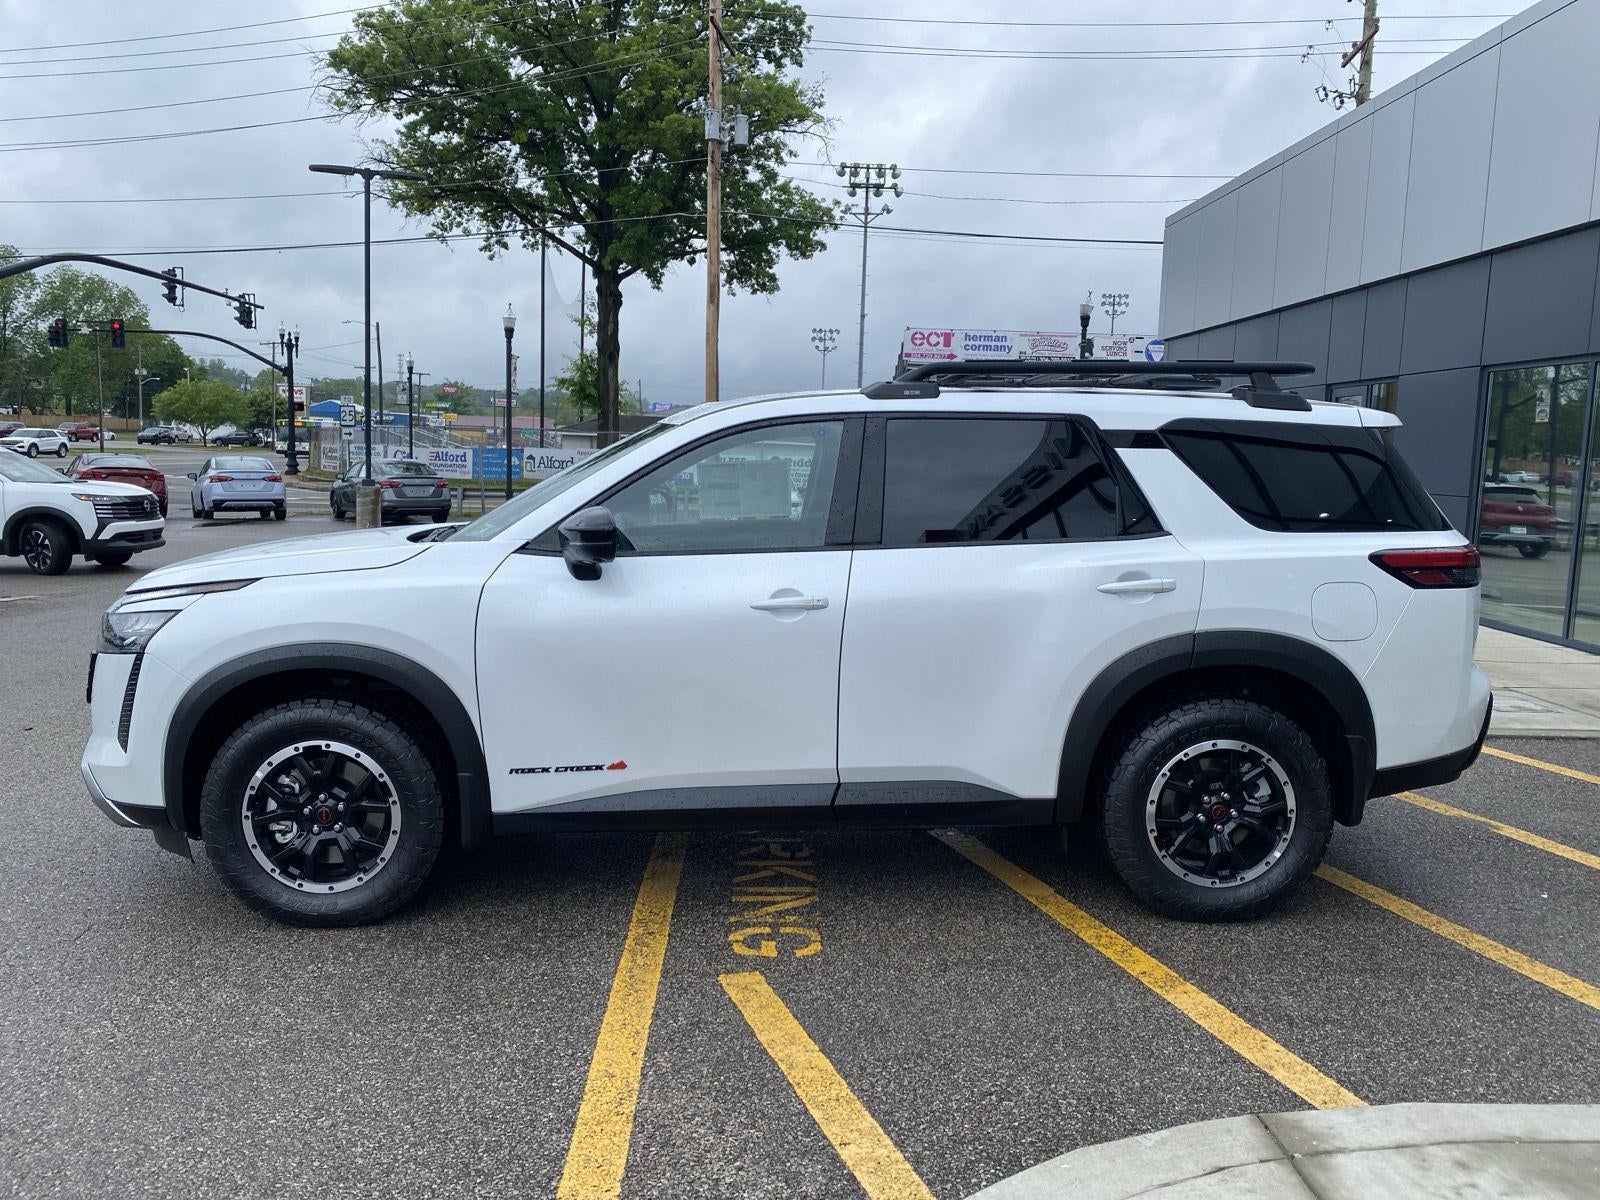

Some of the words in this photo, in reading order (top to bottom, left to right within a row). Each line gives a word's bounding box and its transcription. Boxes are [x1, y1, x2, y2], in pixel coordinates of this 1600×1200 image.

[964, 332, 1008, 342] herman
[963, 343, 1013, 354] cormany
[341, 409, 354, 421] 25
[434, 451, 467, 462] Alford
[537, 455, 574, 469] Alford
[554, 764, 606, 773] CREEK
